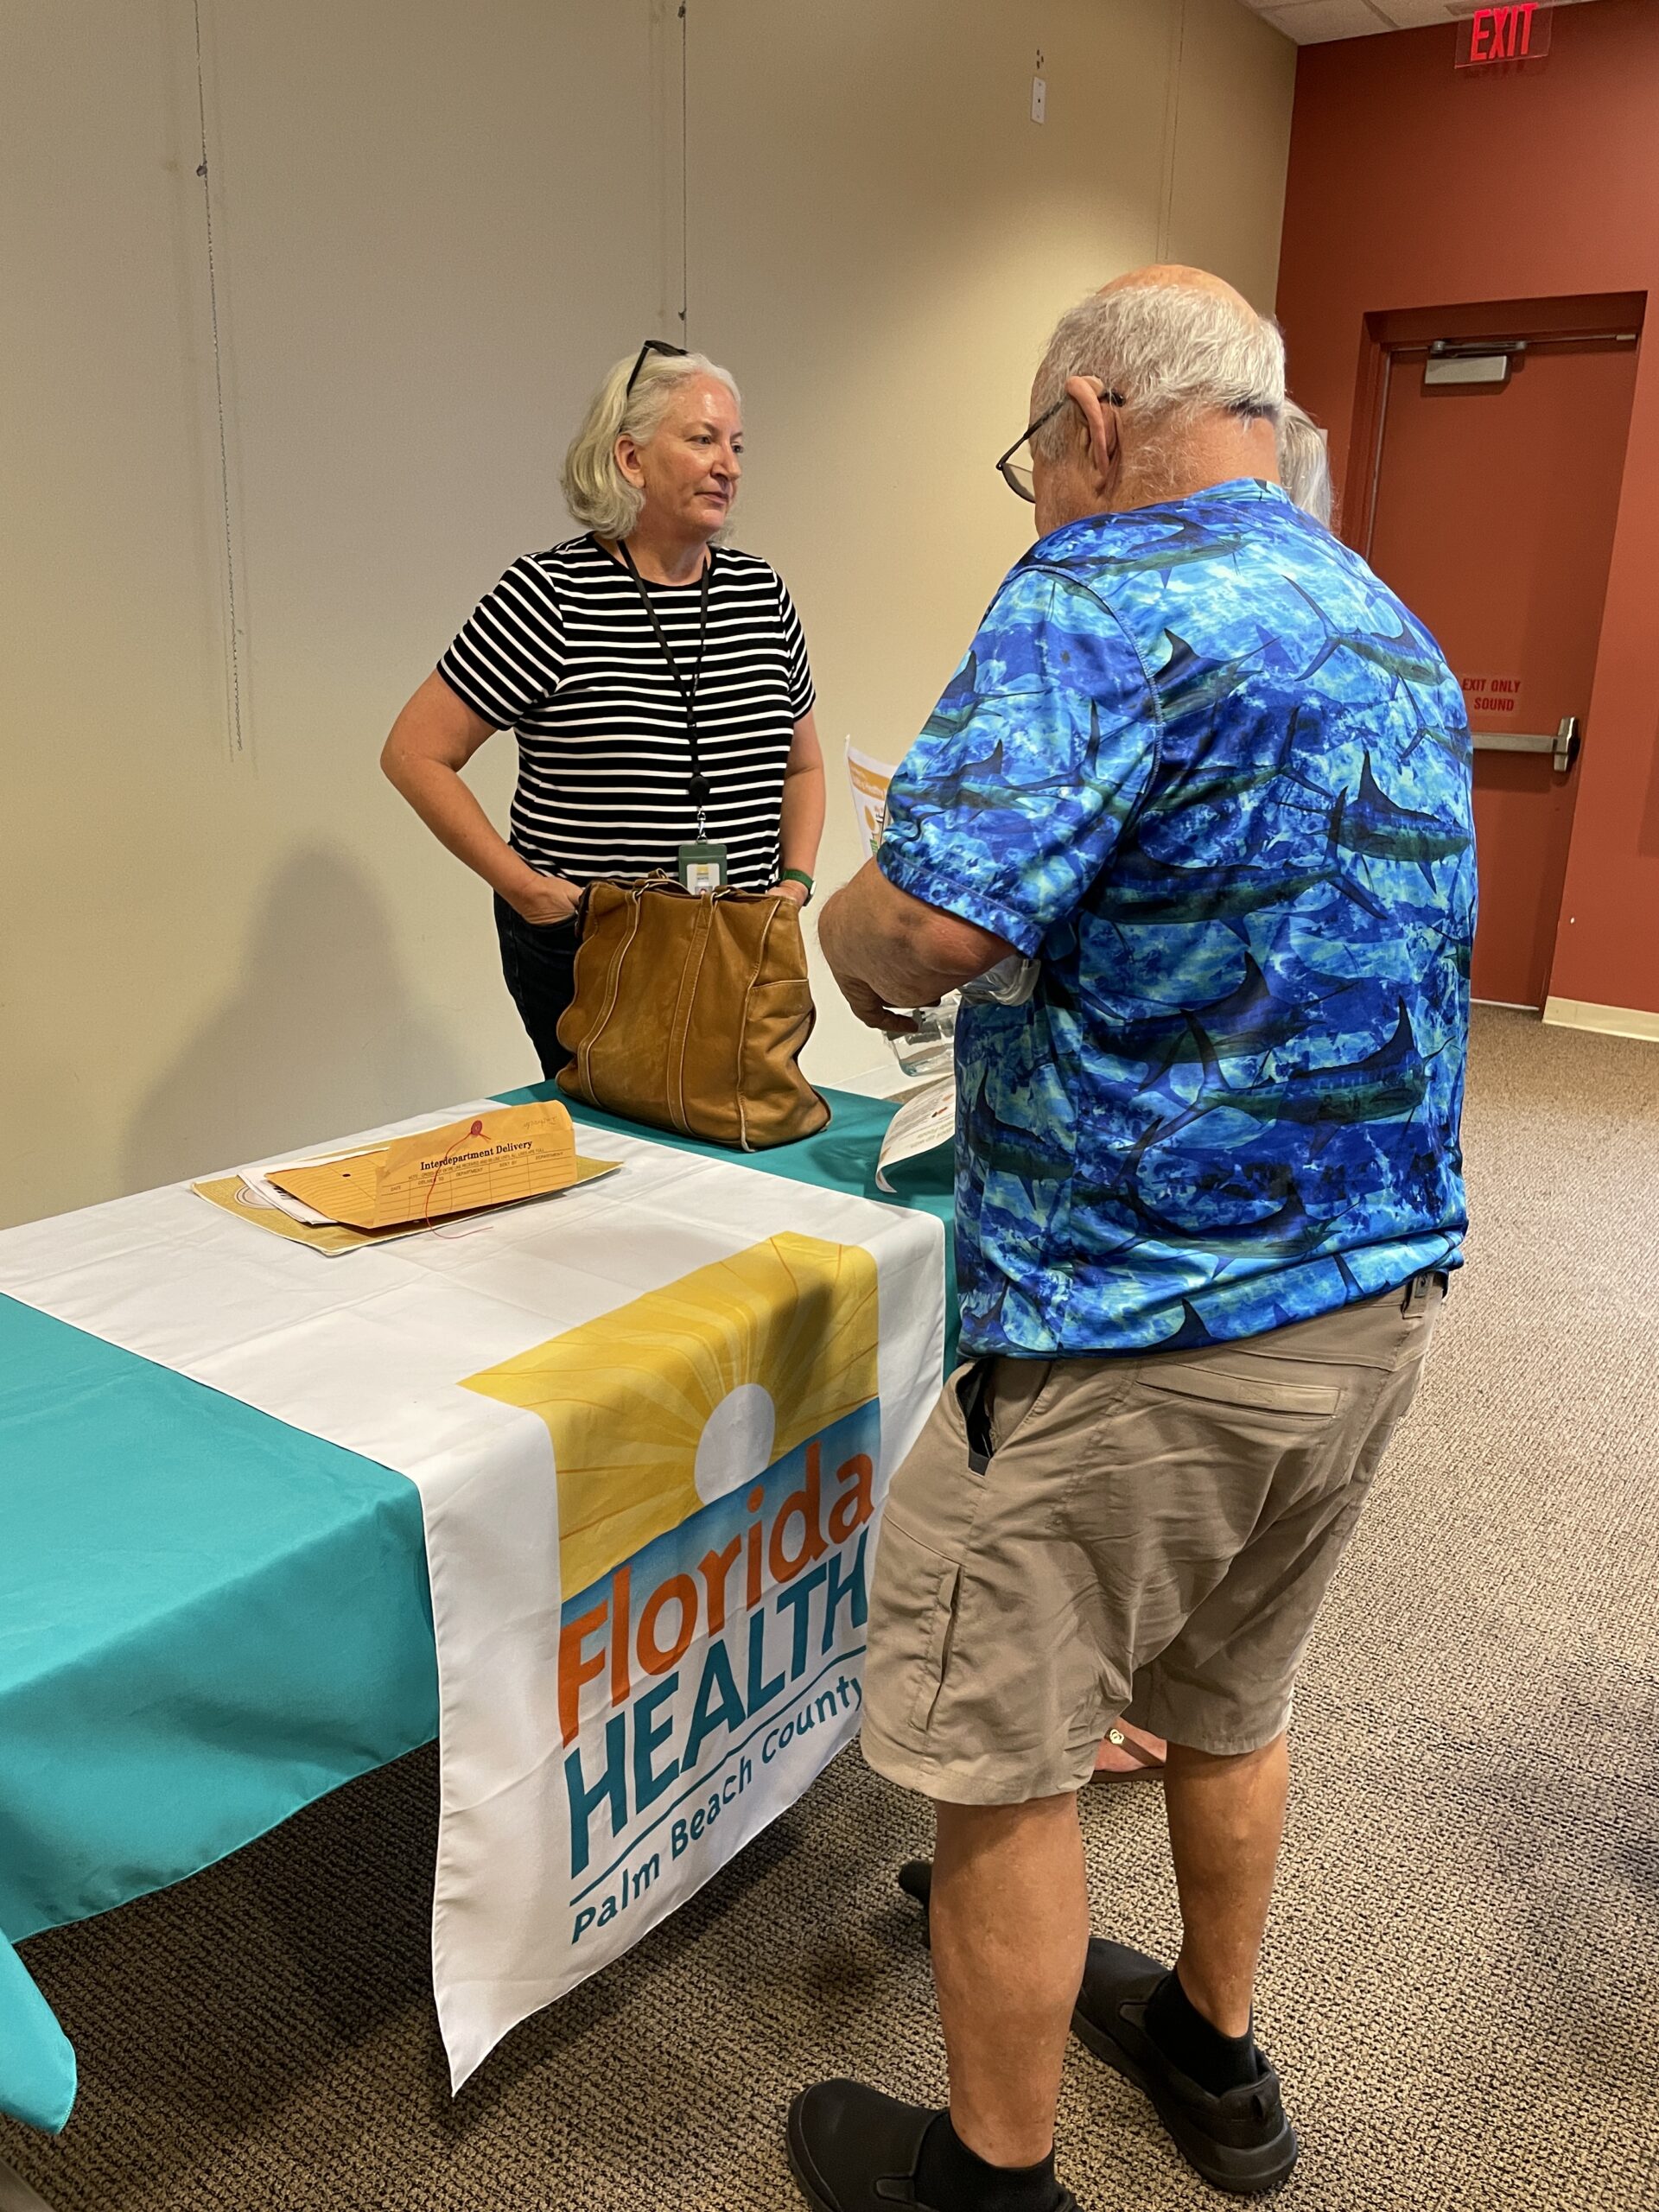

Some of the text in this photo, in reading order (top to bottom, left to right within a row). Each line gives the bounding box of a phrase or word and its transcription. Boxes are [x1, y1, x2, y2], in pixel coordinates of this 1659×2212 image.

[1471, 2, 1539, 61] EXIT
[1462, 678, 1521, 693] EXIT ONLY
[1474, 697, 1514, 711] SOUND
[420, 1141, 533, 1171] Interdepartment Delivery
[535, 1152, 564, 1160] DEPARTMENT
[455, 1166, 484, 1177] DEPARTMENT
[558, 1440, 874, 1749] Florida
[563, 1526, 869, 1878] HEALTH
[570, 1675, 862, 1945] Palm Beach County
